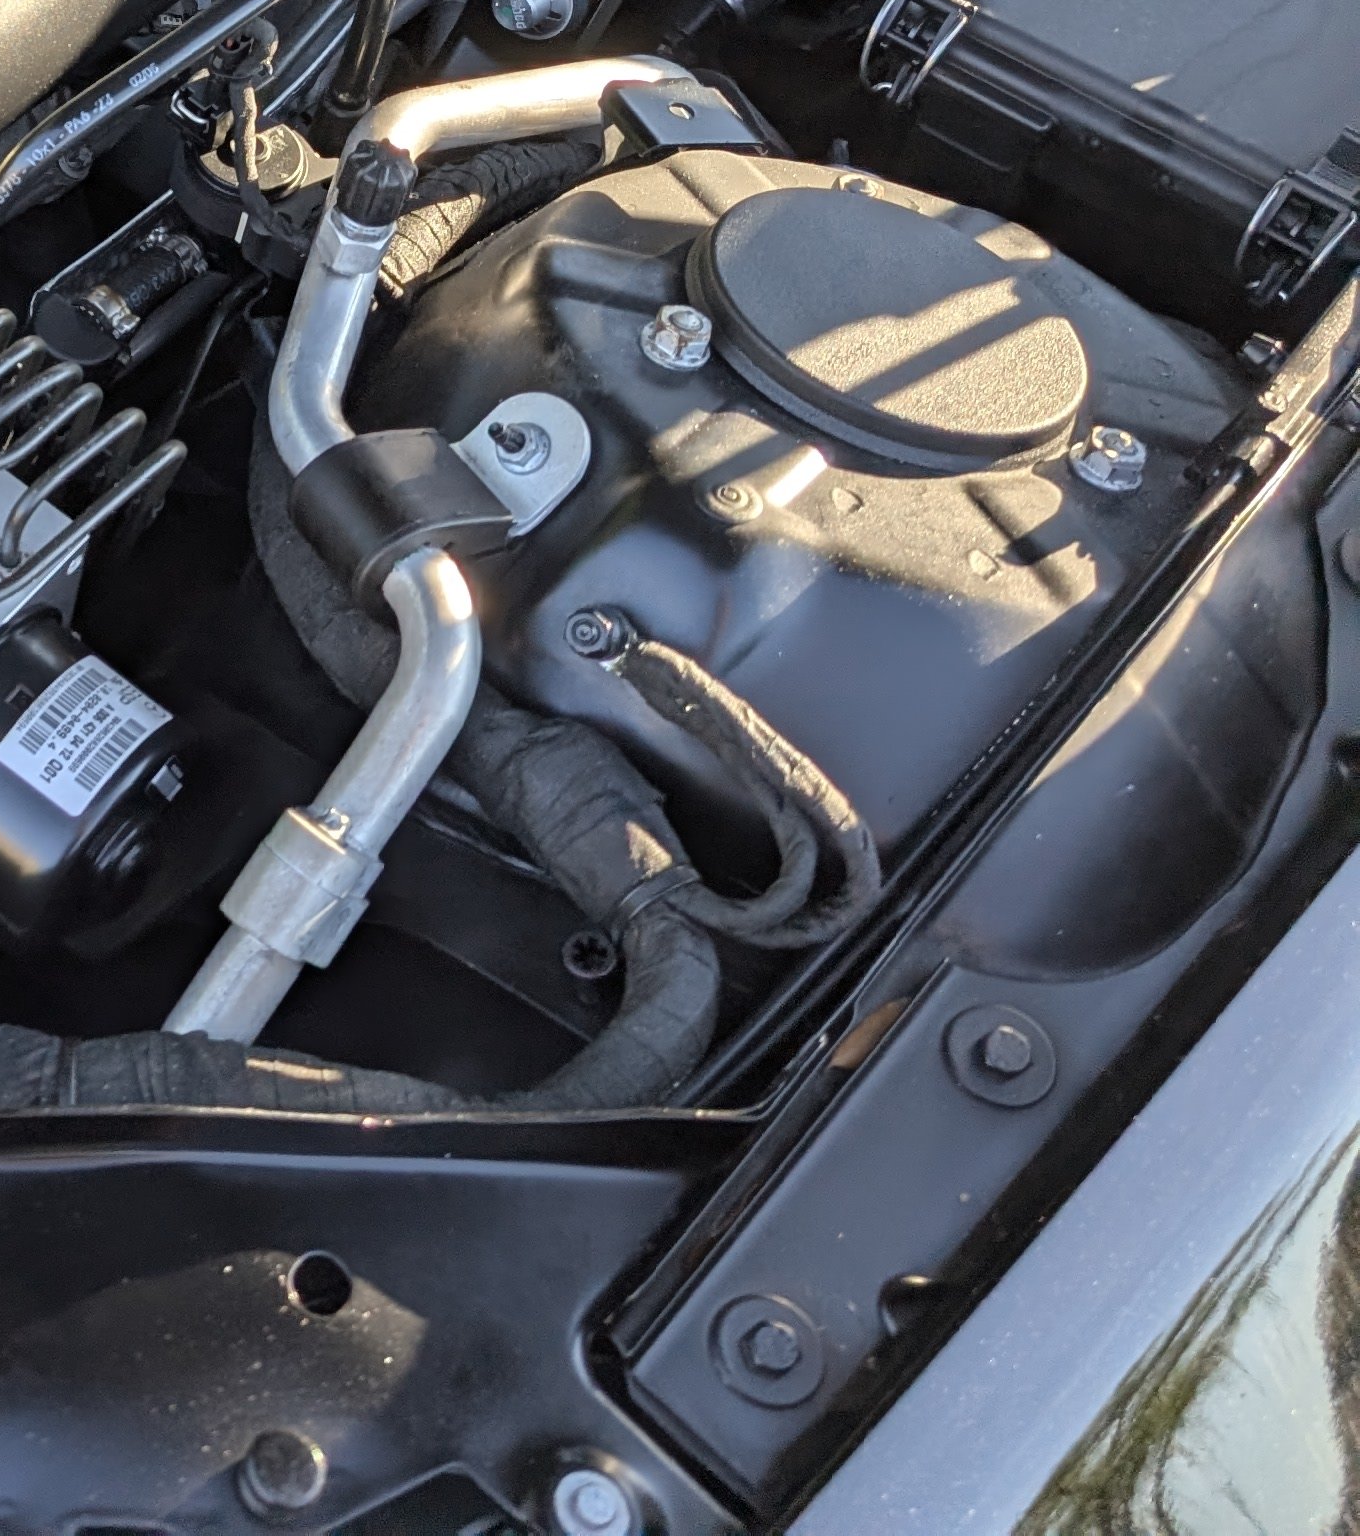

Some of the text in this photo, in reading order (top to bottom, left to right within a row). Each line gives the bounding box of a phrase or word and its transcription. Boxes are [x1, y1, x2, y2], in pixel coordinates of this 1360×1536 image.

[63, 109, 92, 134] PA6
[69, 733, 83, 748] 04
[59, 745, 73, 761] 12
[39, 757, 62, 785] Q01
